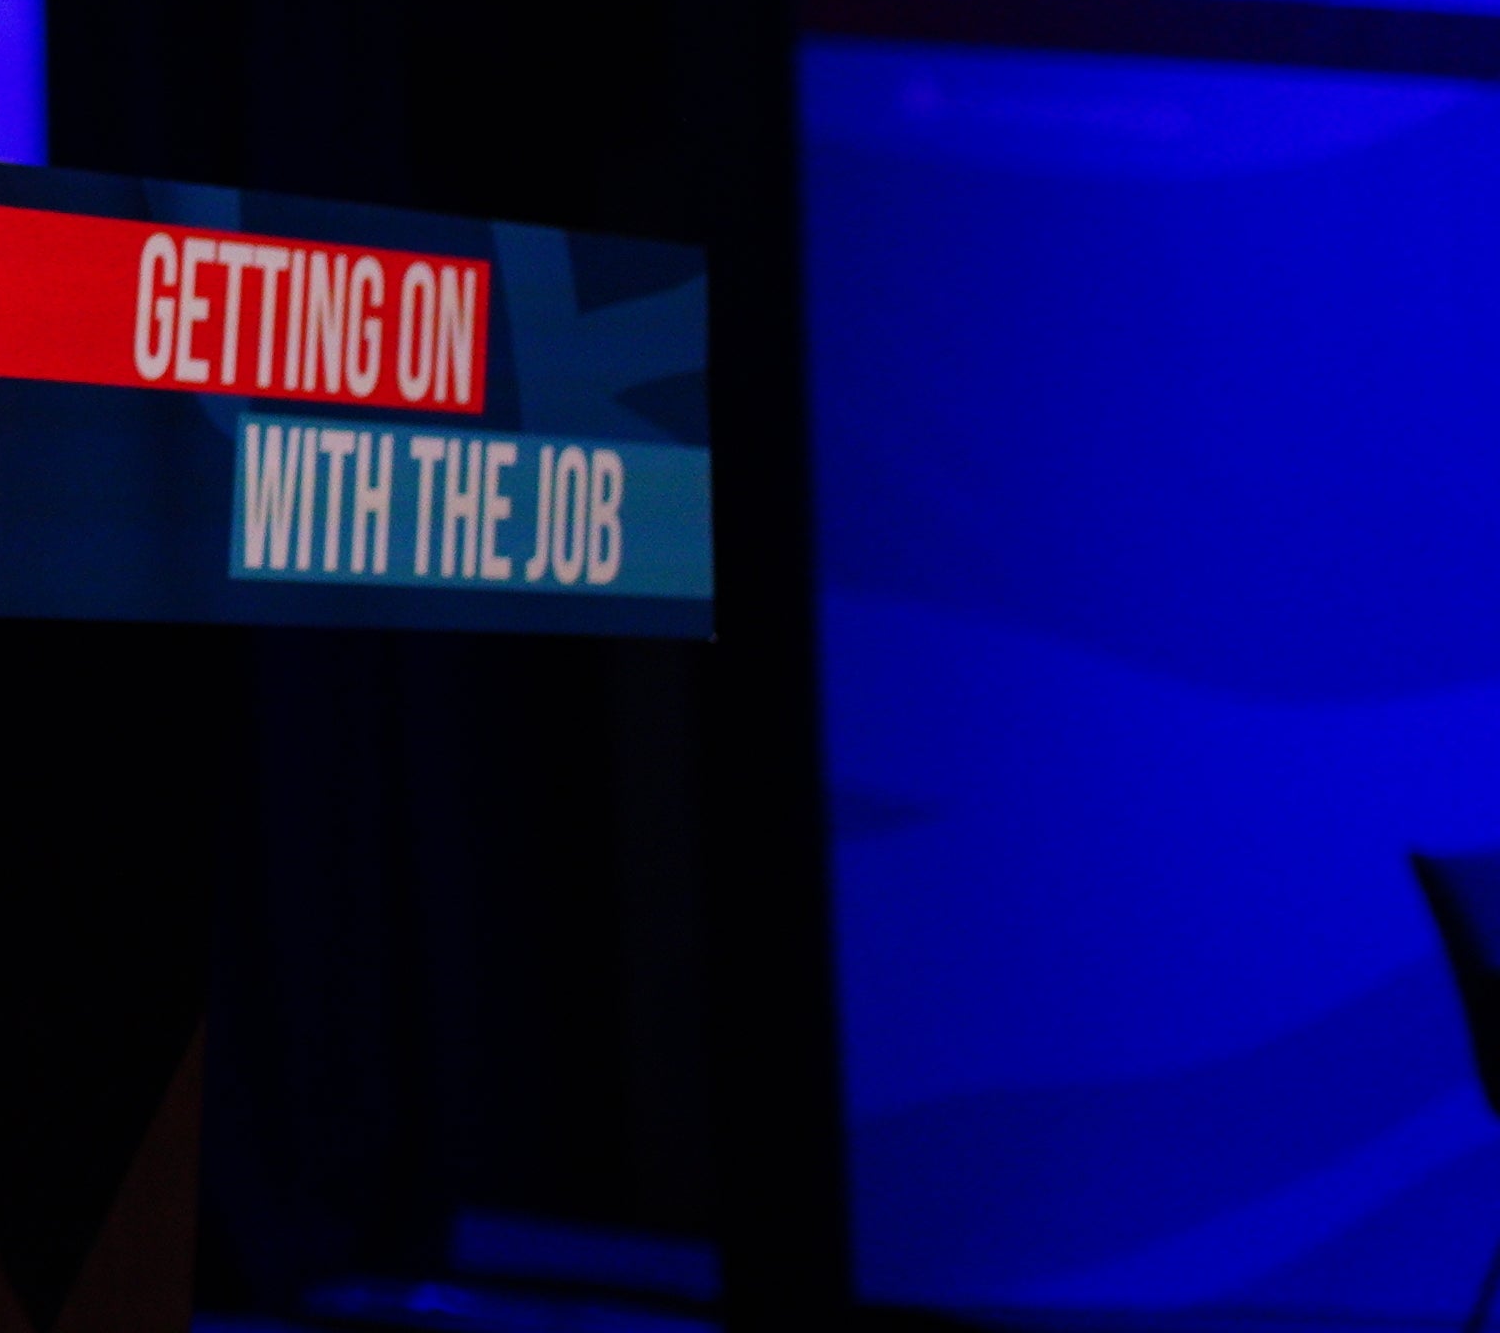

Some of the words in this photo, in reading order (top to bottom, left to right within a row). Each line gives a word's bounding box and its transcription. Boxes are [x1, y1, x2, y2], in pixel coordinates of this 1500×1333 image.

[133, 232, 384, 398] GETTING
[396, 261, 478, 406] ON
[242, 422, 395, 576] WITH
[409, 435, 519, 580] THE
[524, 444, 625, 587] JOB
